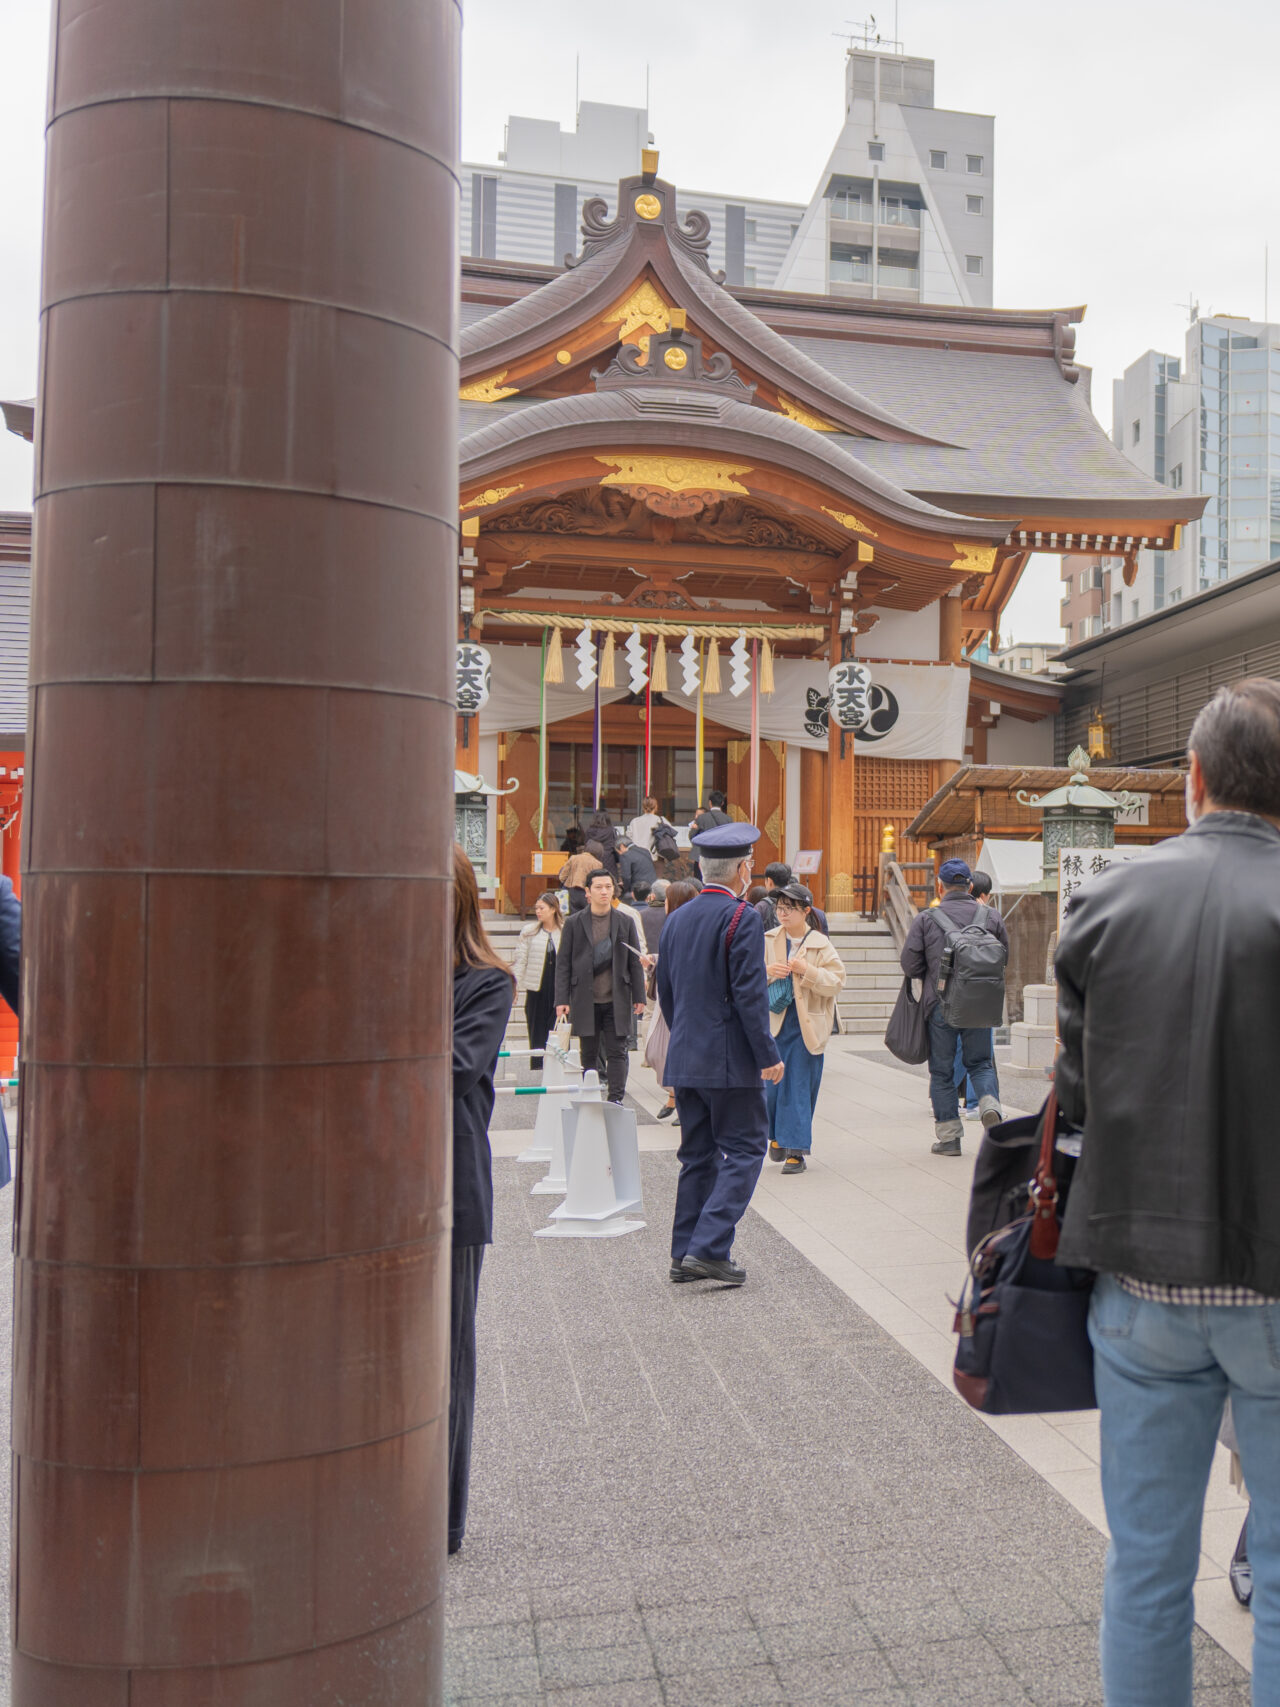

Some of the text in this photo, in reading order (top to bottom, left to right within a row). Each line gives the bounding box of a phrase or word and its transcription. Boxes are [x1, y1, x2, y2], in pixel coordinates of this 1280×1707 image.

[456, 647, 483, 709] 水天宮
[836, 665, 865, 726] 水天宮
